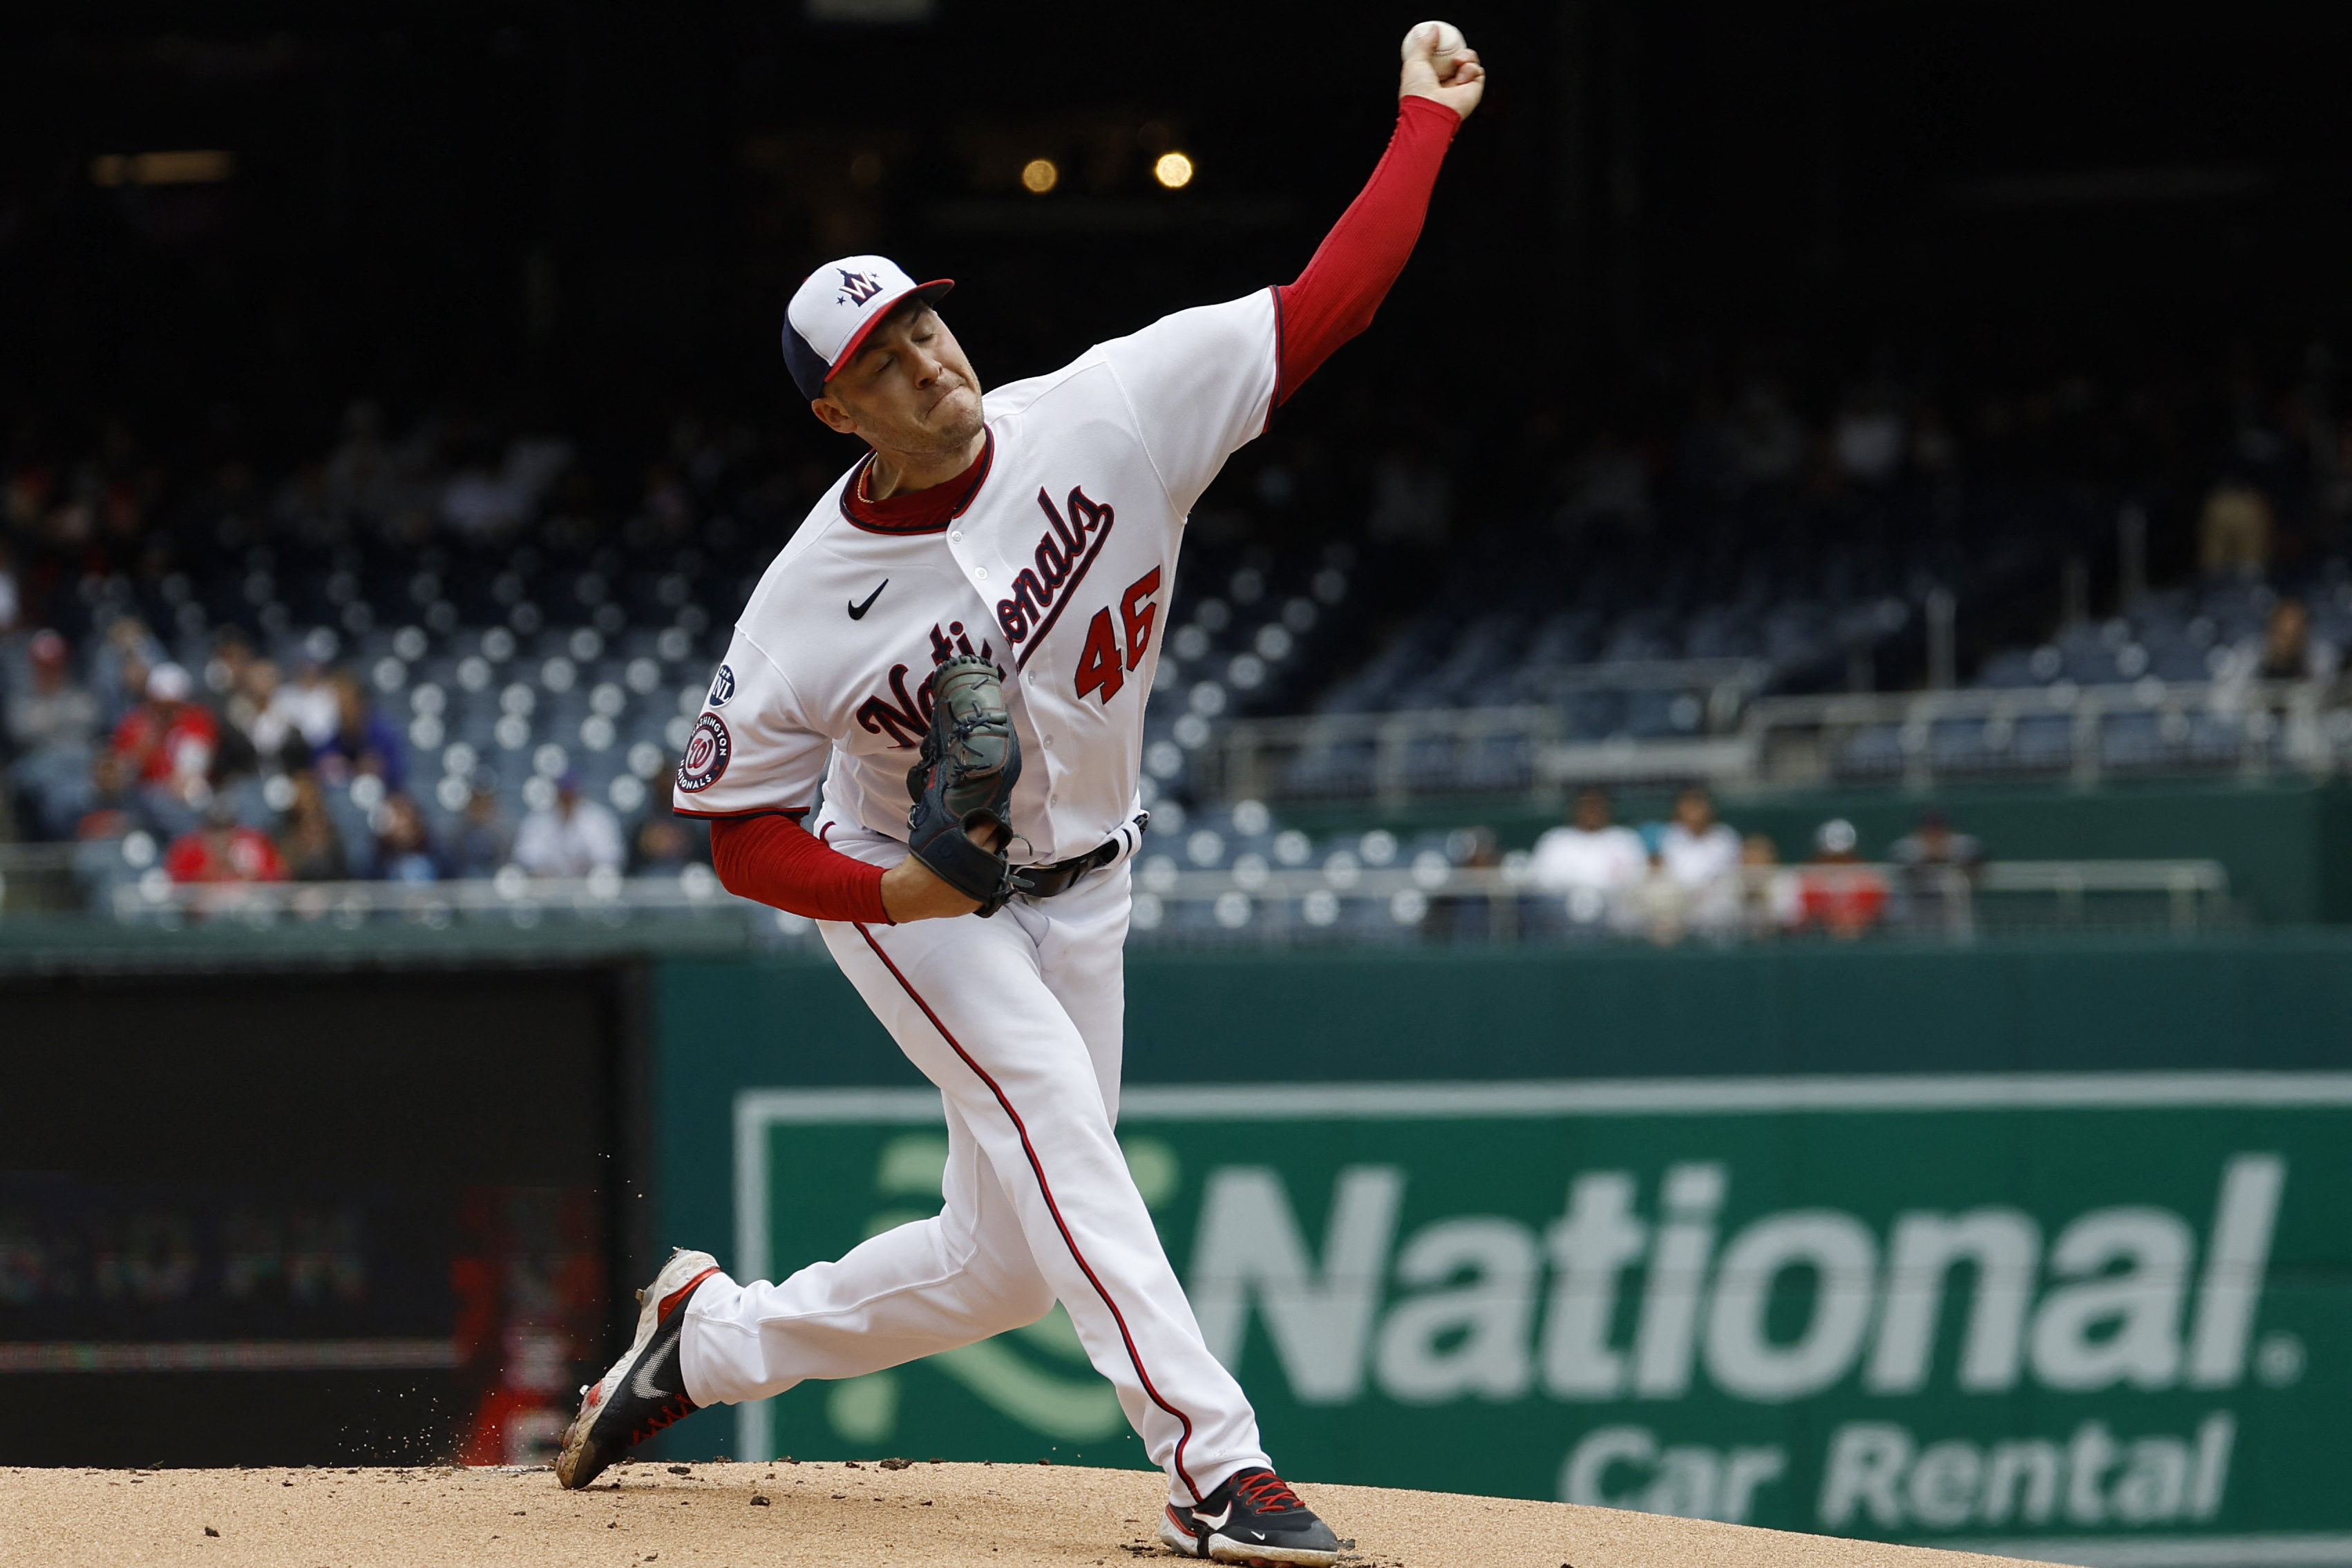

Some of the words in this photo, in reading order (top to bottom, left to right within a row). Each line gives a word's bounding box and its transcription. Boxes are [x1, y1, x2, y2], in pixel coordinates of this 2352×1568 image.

[839, 271, 876, 300] W
[1074, 564, 1161, 705] 46
[712, 676, 732, 703] NL
[691, 716, 727, 756] WASHINGTON
[1187, 1153, 2288, 1406] National
[1557, 1423, 1788, 1525] Car
[1819, 1408, 2237, 1524] Rental
